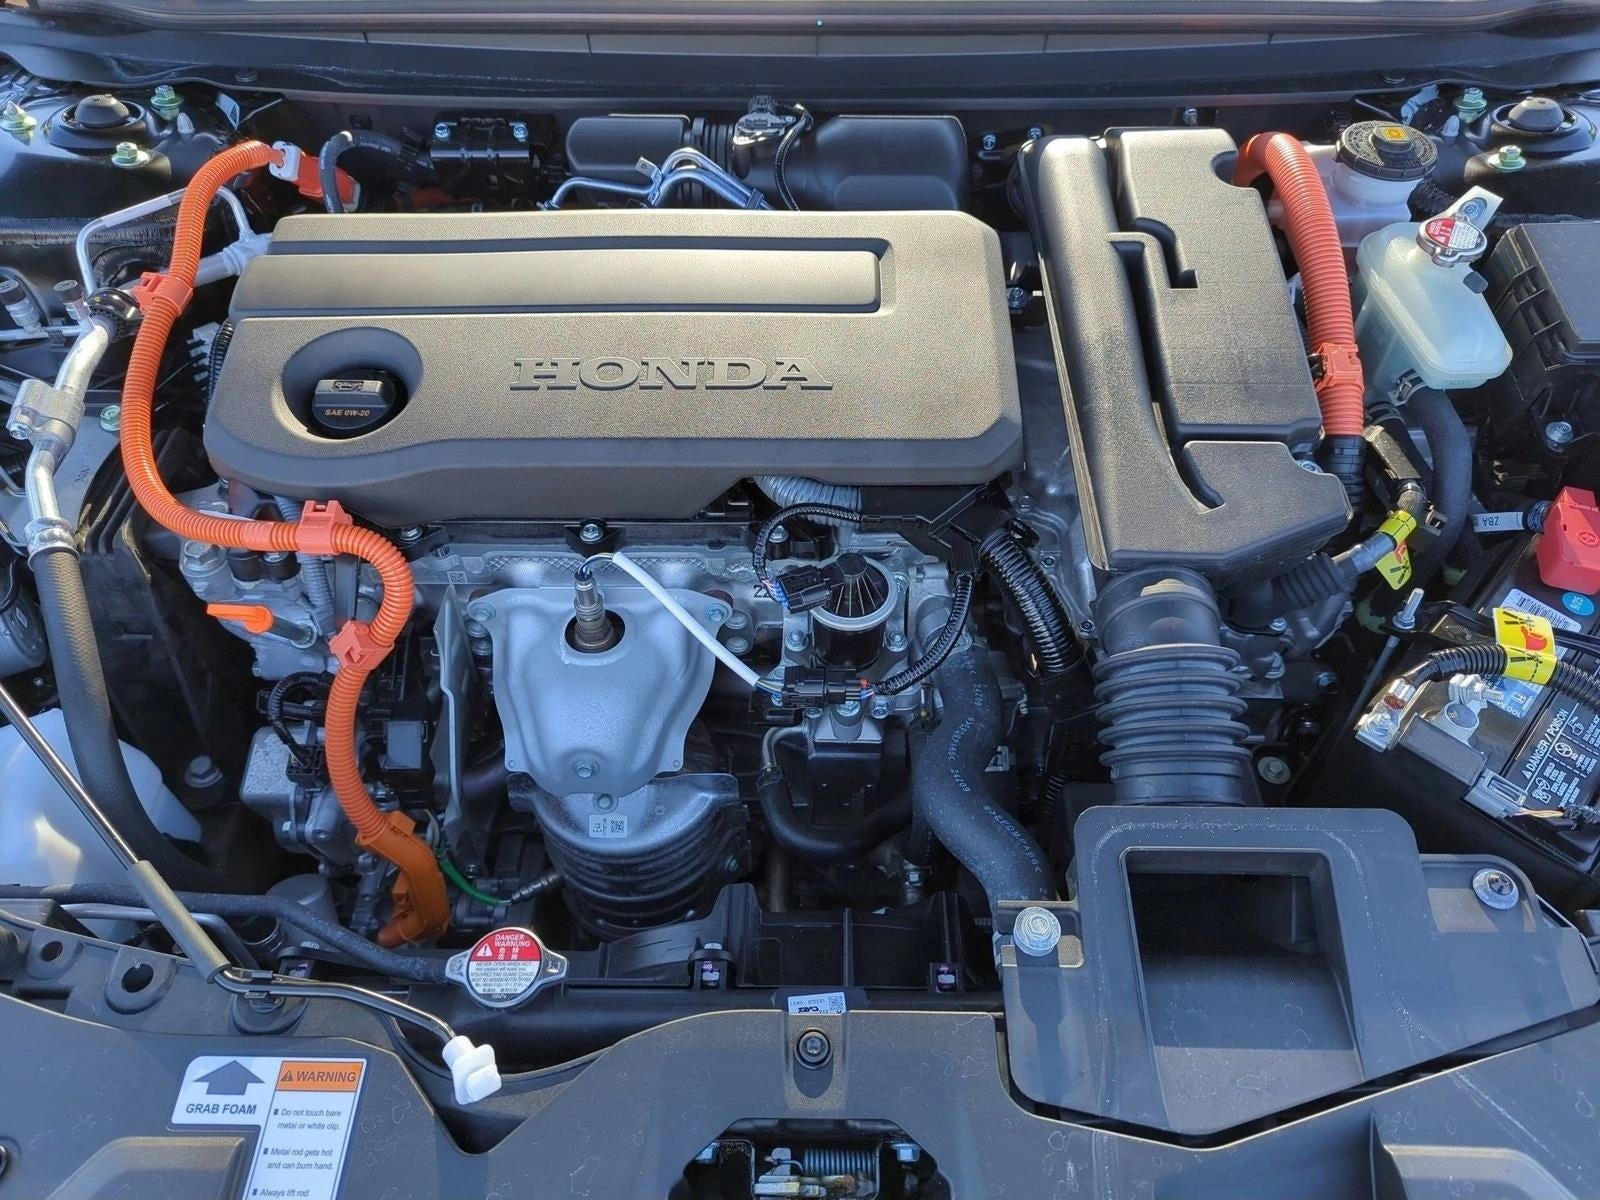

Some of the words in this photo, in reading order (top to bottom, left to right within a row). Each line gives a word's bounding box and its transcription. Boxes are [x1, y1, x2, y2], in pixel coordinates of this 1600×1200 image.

[510, 357, 833, 391] HONDA
[1482, 517, 1499, 526] ZBA
[1506, 706, 1521, 718] 100
[1525, 738, 1550, 771] DANGER
[1547, 708, 1568, 735] POISON
[494, 940, 530, 948] WARNUNG
[296, 1071, 356, 1082] WARNING
[186, 1104, 219, 1114] GRAB
[222, 1104, 257, 1115] FOAM
[281, 1108, 291, 1116] Do
[293, 1108, 304, 1116] not
[305, 1108, 323, 1116] touch
[308, 1122, 326, 1130] white
[327, 1122, 340, 1131] clip.
[270, 1148, 290, 1156] Metal
[292, 1148, 304, 1156] rod
[304, 1150, 320, 1158] gets
[267, 1161, 281, 1169] and
[314, 1162, 332, 1170] hand.
[260, 1188, 284, 1198] Always
